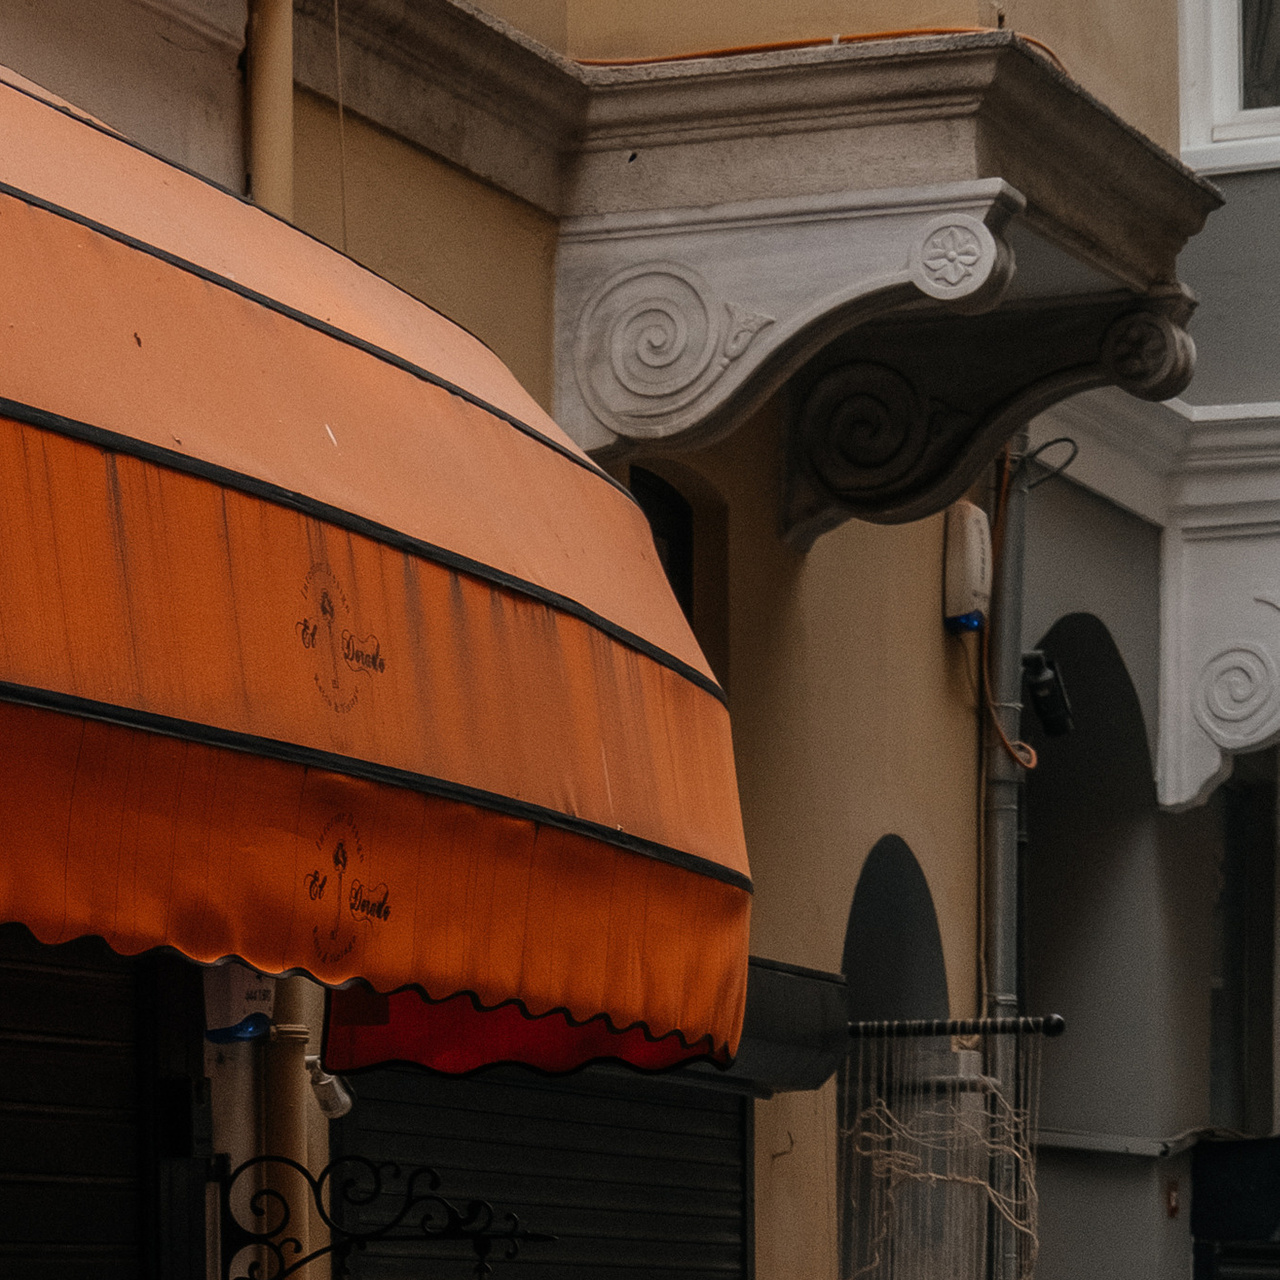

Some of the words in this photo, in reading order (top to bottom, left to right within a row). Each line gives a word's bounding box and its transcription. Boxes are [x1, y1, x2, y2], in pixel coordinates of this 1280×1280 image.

[295, 617, 318, 649] El
[341, 629, 385, 679] Dorado
[303, 869, 328, 901] El
[349, 878, 391, 929] Dorado
